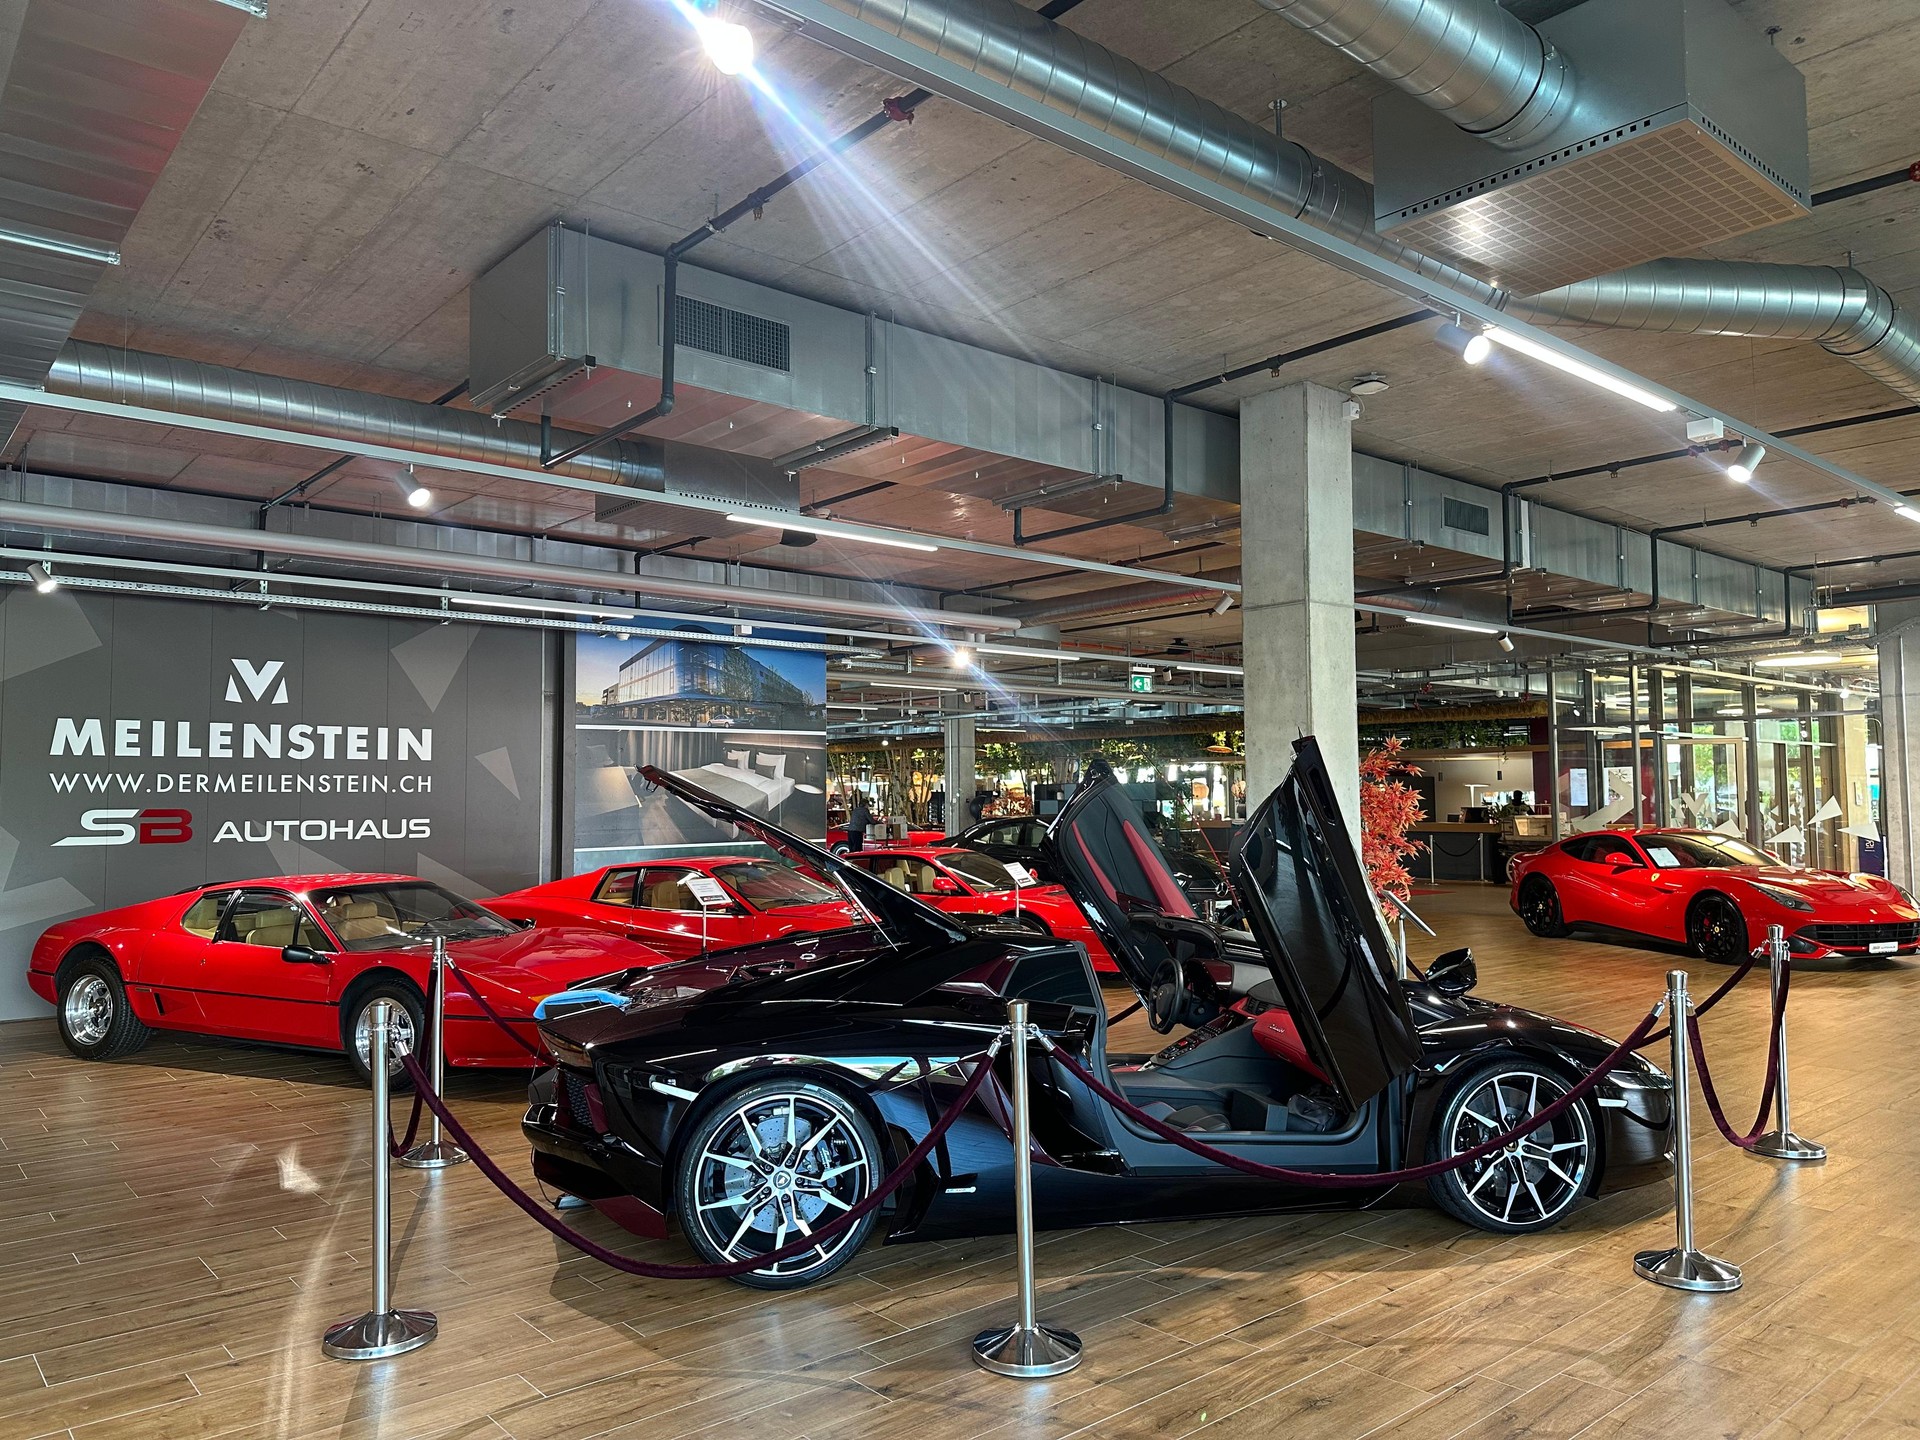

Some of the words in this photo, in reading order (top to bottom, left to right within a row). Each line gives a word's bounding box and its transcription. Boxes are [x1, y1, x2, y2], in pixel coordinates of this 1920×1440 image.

[49, 717, 432, 761] MEILENSTEIN
[49, 773, 432, 793] WWW.DERMEILENSTEIN.CH
[50, 808, 193, 847] SB
[213, 818, 431, 843] AUTOHAUS
